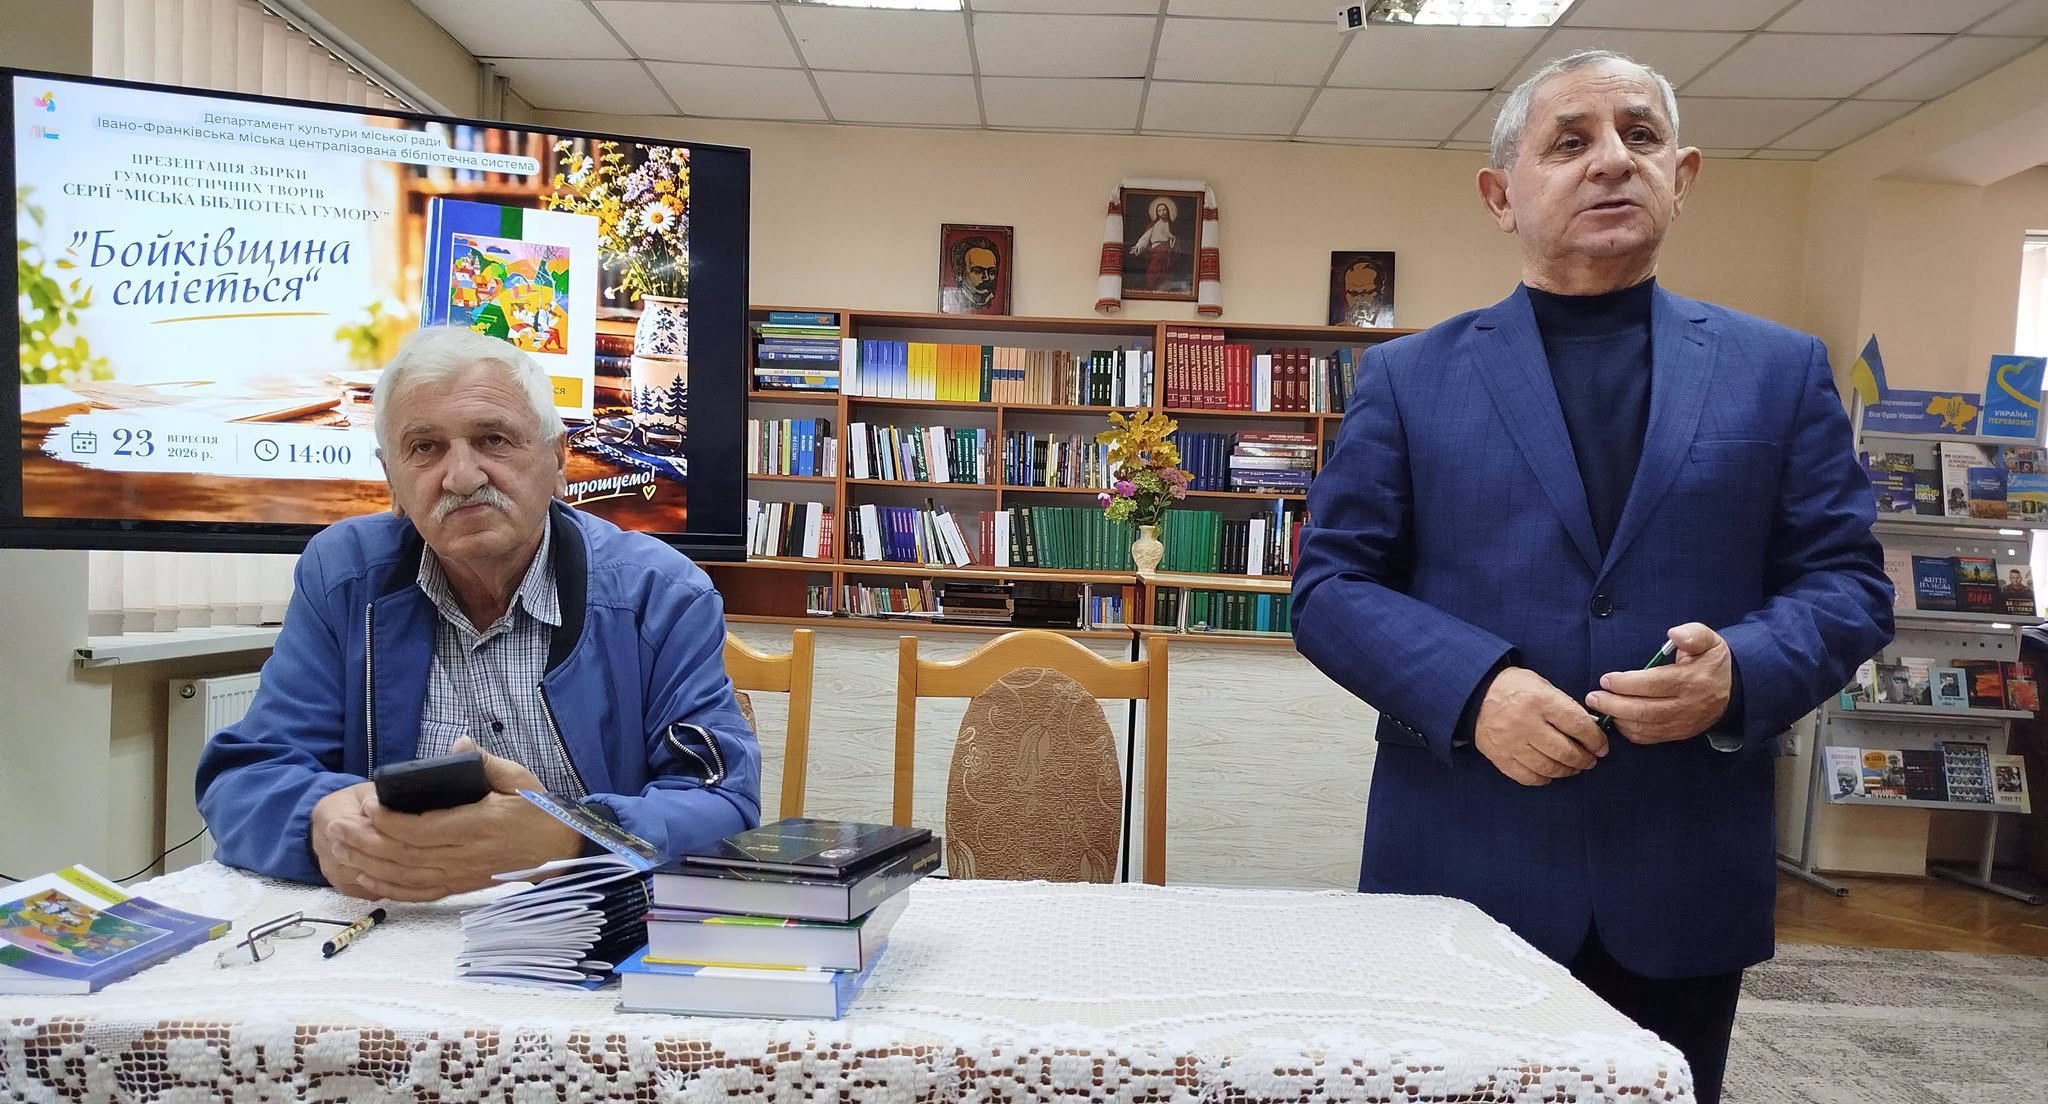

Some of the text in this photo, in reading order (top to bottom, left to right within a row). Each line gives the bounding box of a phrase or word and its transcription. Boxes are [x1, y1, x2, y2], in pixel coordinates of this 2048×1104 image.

[97, 116, 536, 172] Івано-Франківська міська централізована бібліотечна система
[203, 112, 442, 148] Департамент культури міської ради
[131, 153, 307, 181] ПРЕЗЕНТАЦІЯ ЗБІРКИ
[113, 170, 325, 199] ГУМОРИСТИЧНИХ ТВОРІВ
[62, 182, 112, 199] СЕРІЇ
[200, 194, 308, 217] БІБЛІОТЕКА
[1994, 409, 2028, 418] УКРАЇНА
[112, 427, 155, 458] 23
[167, 433, 219, 445] ВЕРЕСНЯ
[167, 446, 214, 462] 2026 р.
[288, 443, 352, 465] 14:00
[564, 465, 656, 502] прошуємо!
